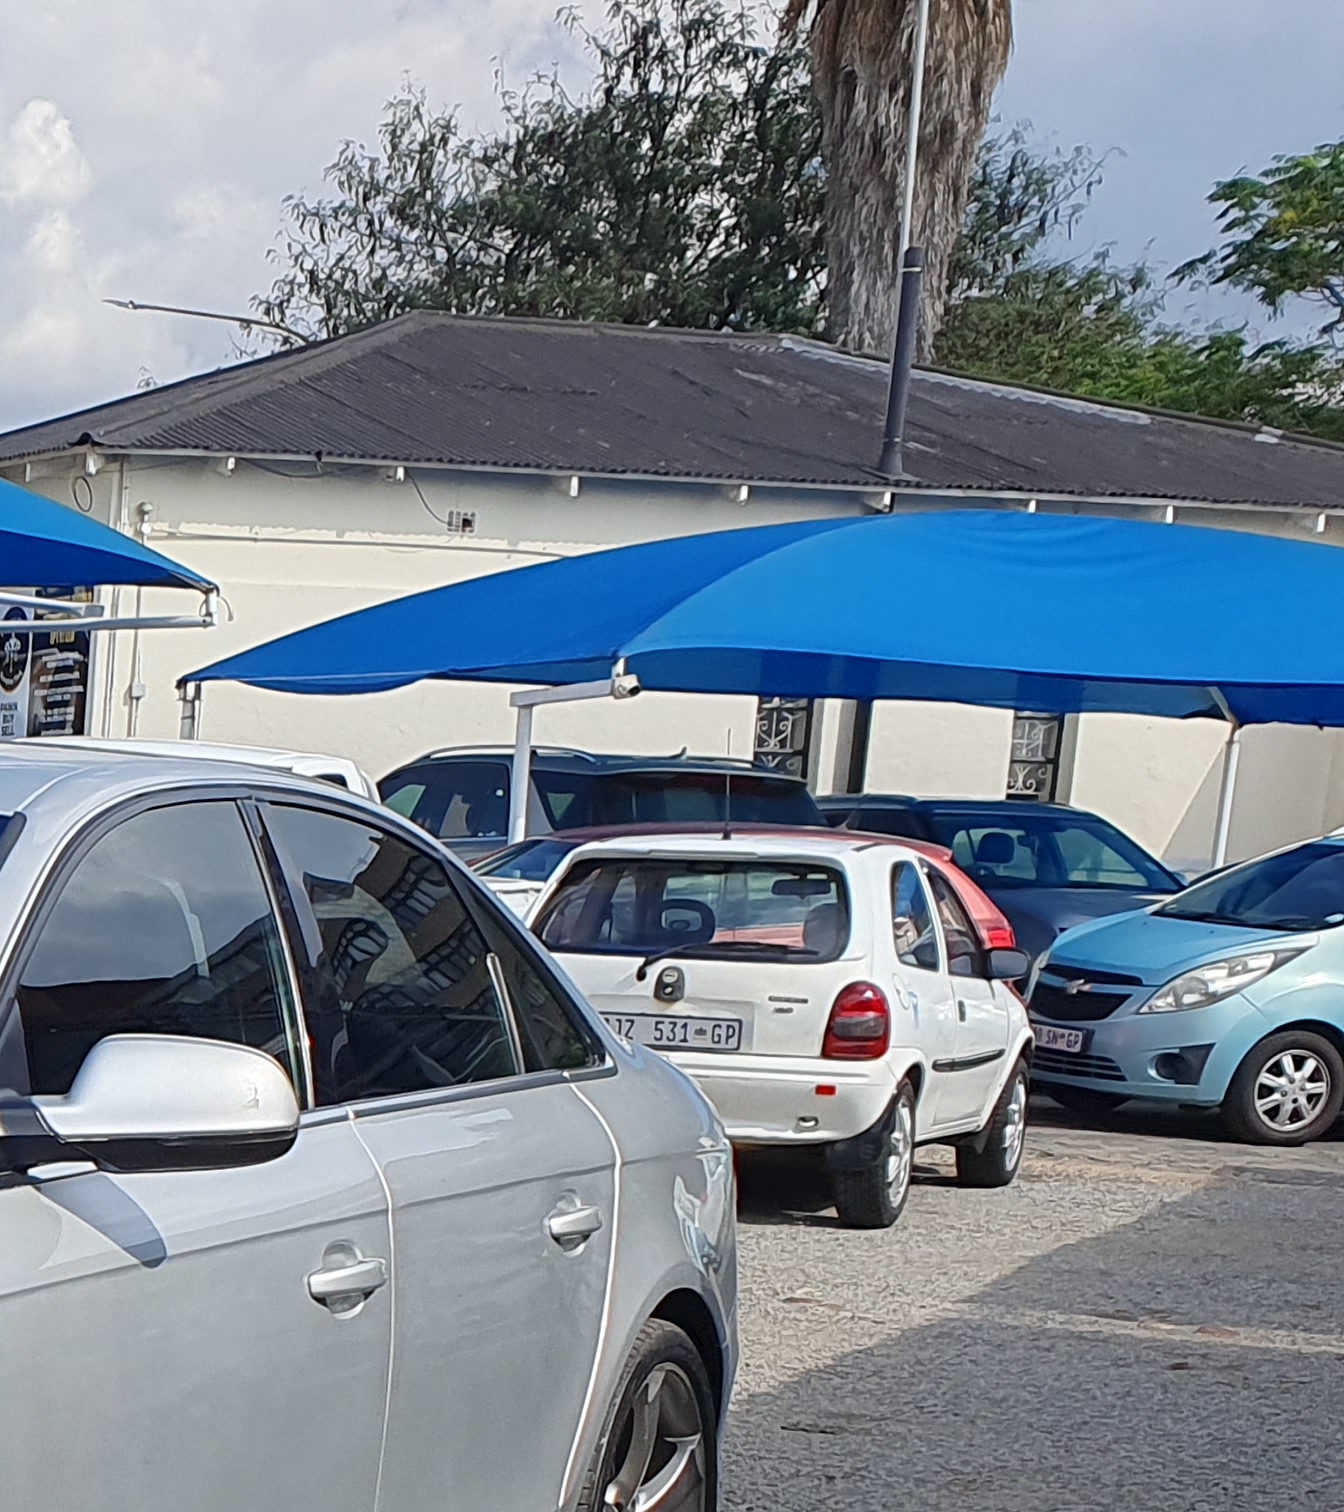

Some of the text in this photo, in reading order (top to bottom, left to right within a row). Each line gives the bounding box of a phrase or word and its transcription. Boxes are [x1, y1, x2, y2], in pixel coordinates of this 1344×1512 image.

[603, 1017, 736, 1046] JZ 531 GP
[1065, 1032, 1080, 1049] GP
